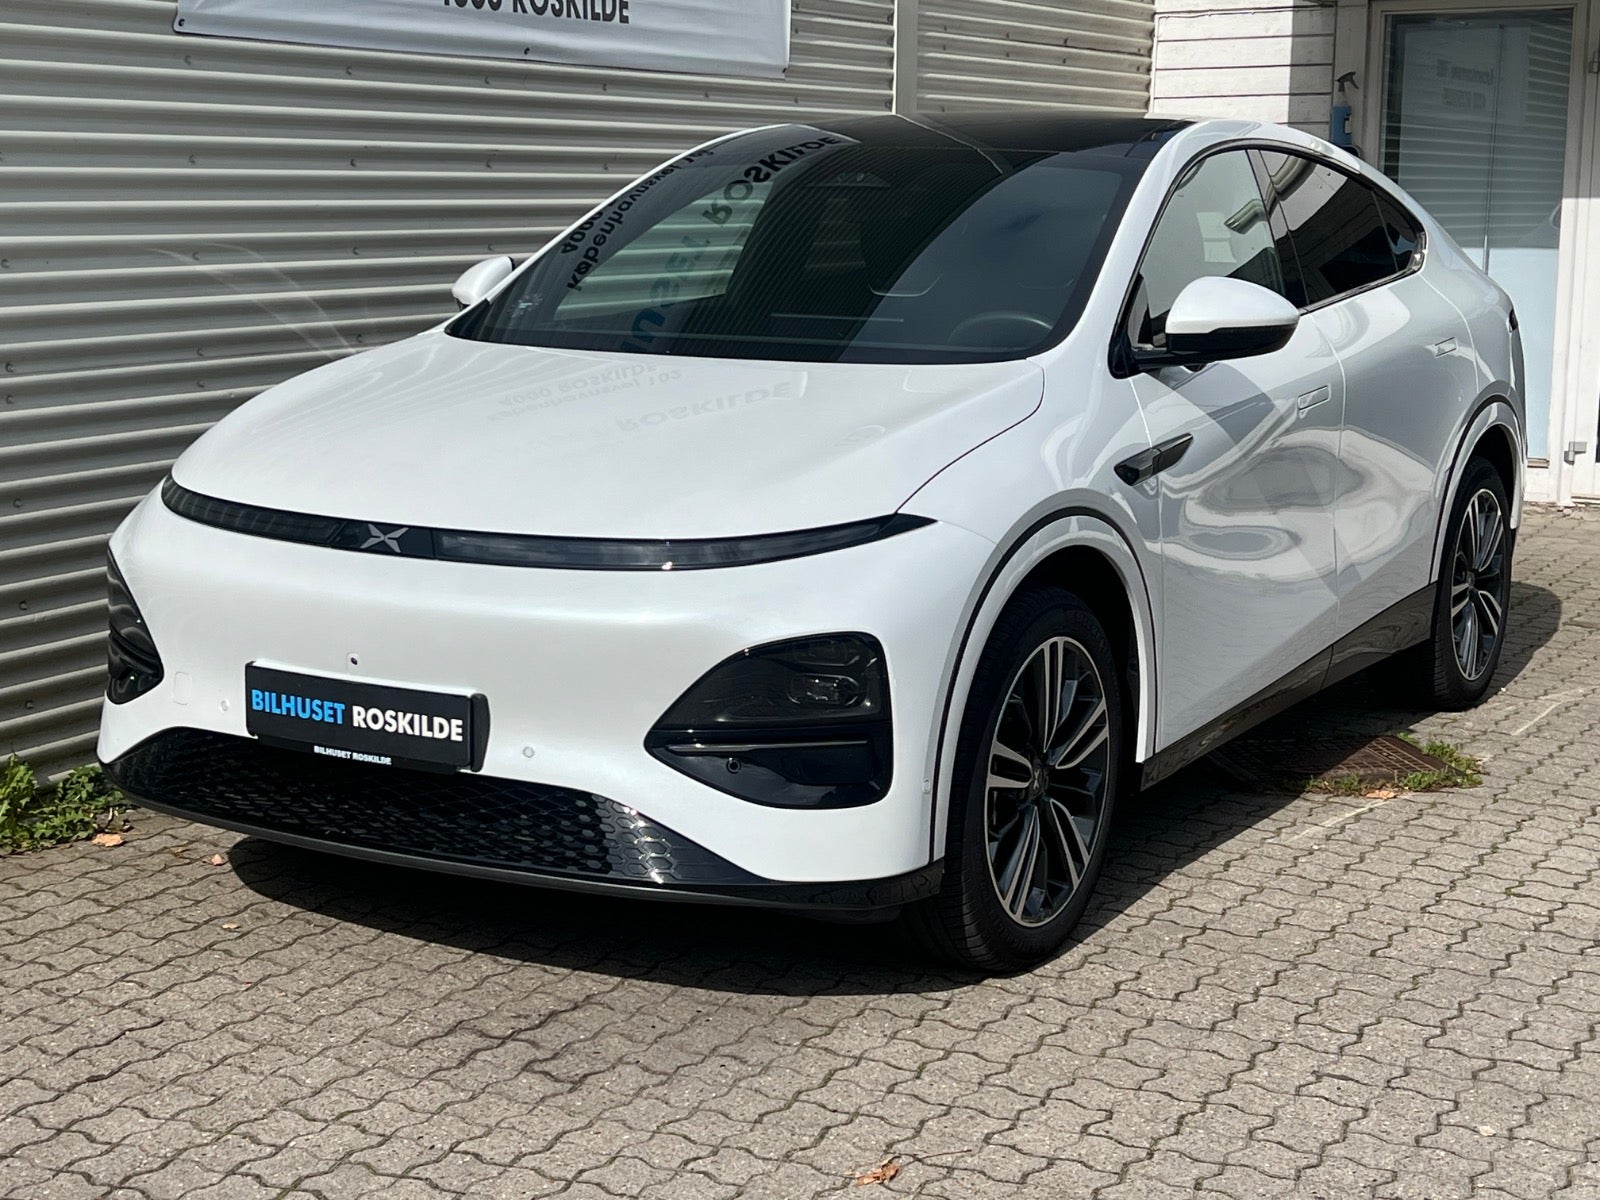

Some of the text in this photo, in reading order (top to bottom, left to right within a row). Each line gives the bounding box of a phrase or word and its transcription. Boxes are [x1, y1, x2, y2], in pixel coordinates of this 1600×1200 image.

[251, 689, 463, 742] BILHUSET ROSKILDE
[313, 745, 392, 765] BILHUSET ROSKILDE
